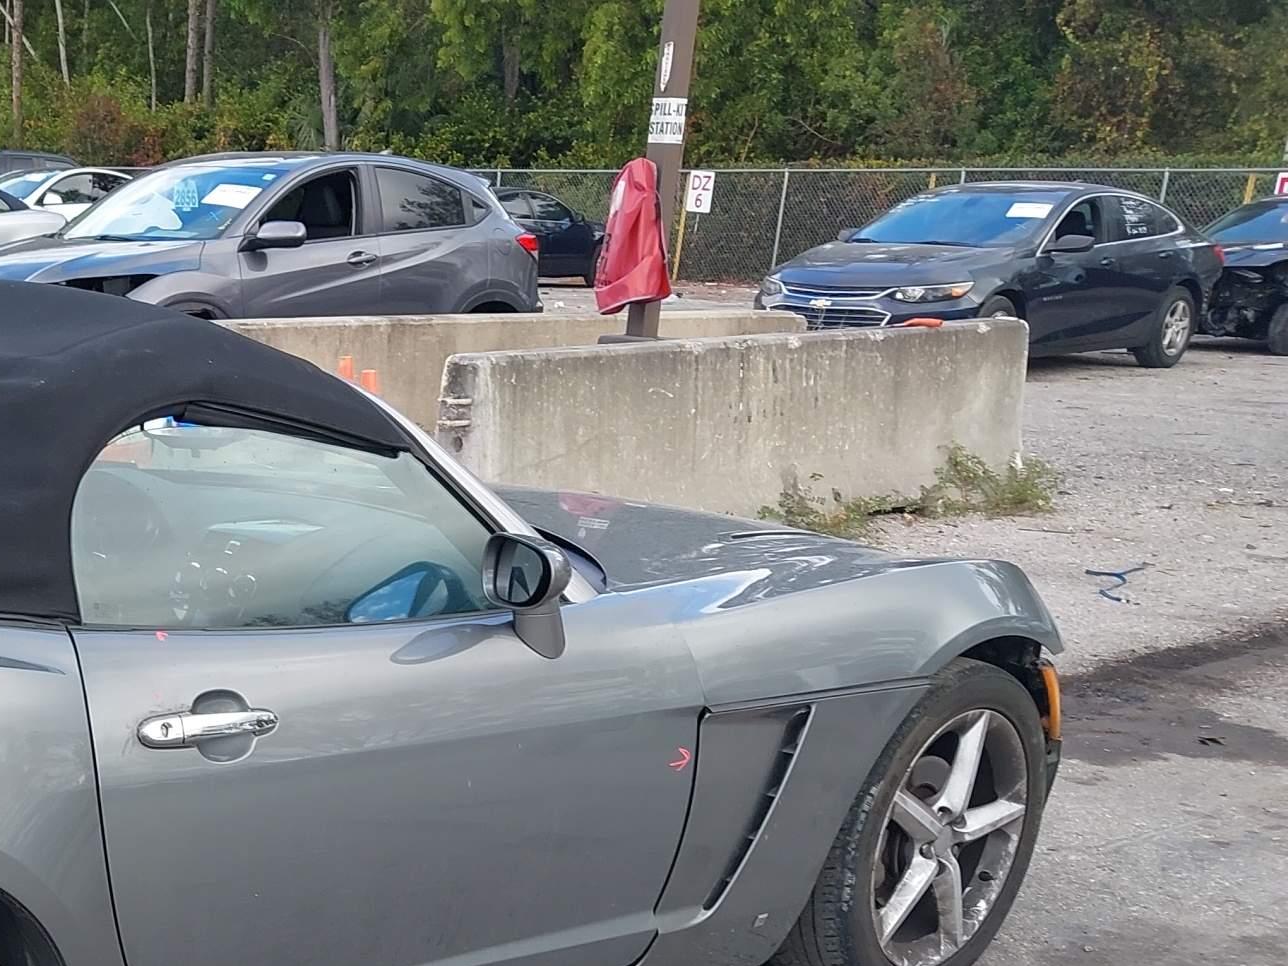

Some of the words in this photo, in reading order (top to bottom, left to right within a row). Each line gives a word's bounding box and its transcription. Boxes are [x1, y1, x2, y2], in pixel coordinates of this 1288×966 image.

[649, 122, 682, 135] STATION
[692, 175, 712, 191] DZ
[175, 189, 197, 206] 2856
[694, 193, 703, 208] 6
